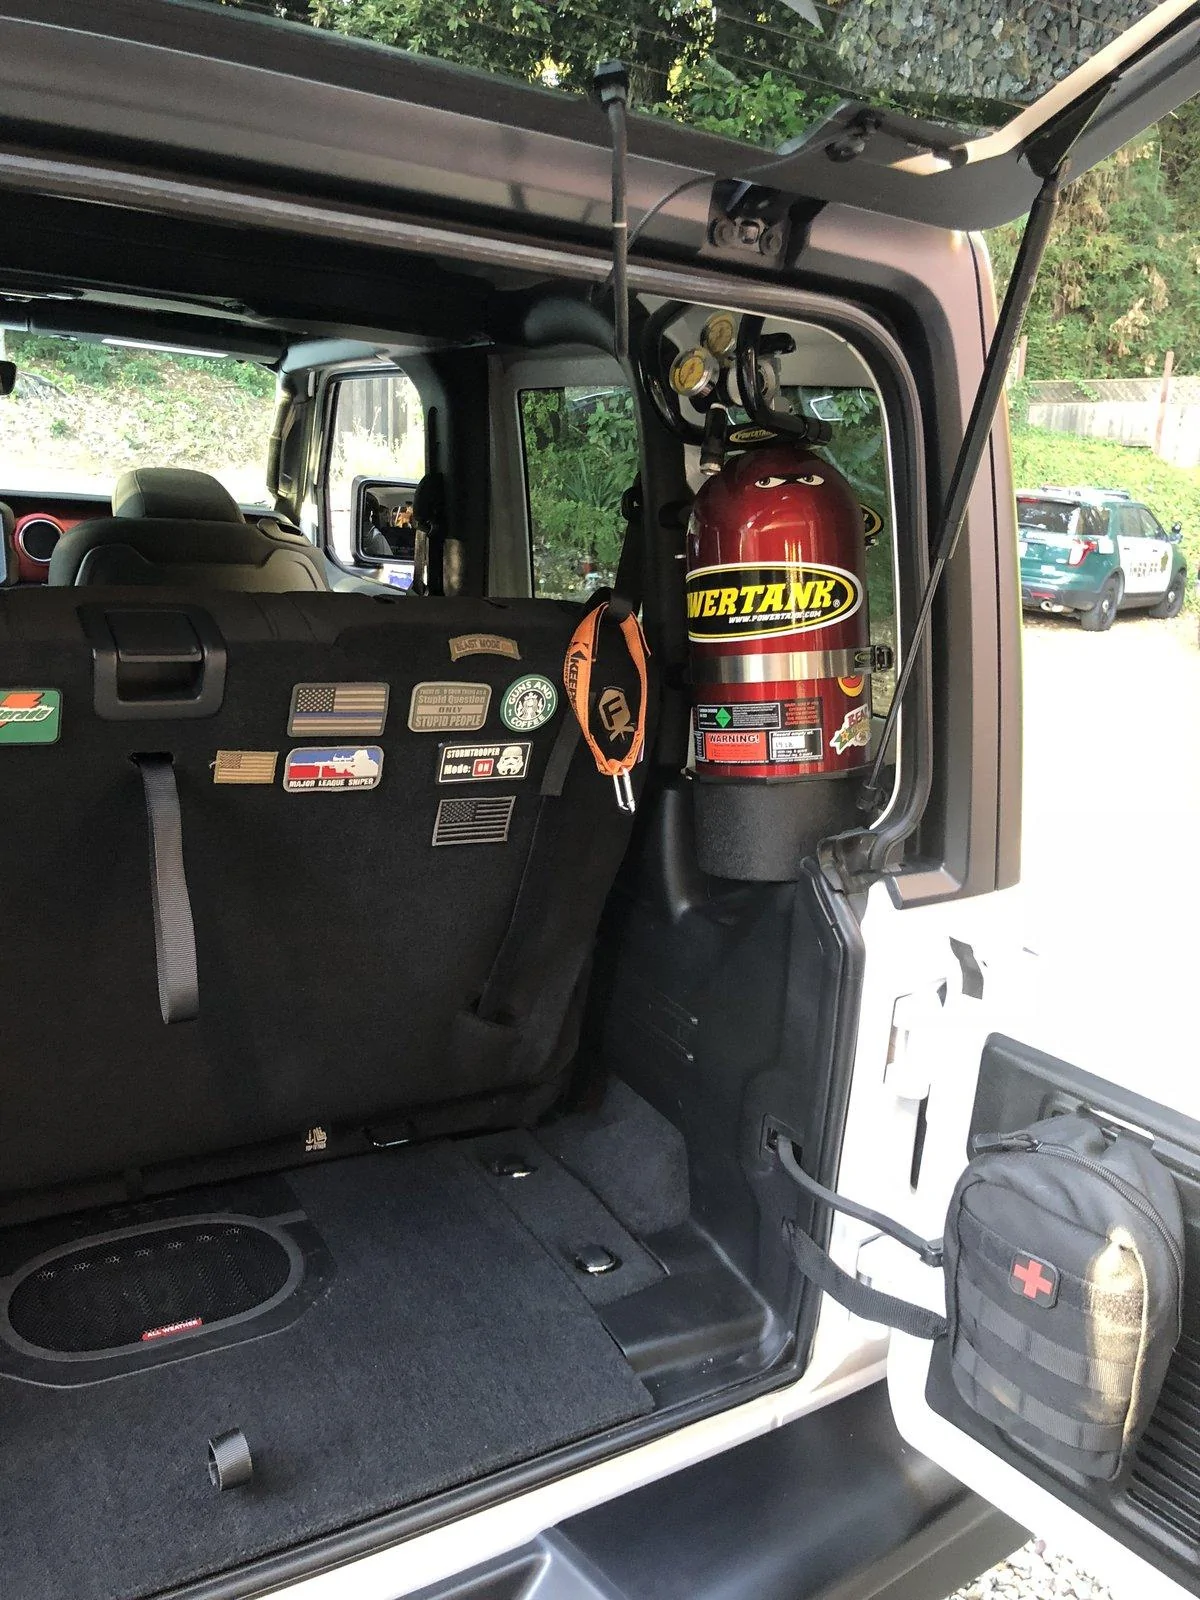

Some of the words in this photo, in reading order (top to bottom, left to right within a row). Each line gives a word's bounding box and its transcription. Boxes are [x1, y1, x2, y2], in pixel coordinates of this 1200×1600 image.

[687, 580, 837, 618] WERTANK
[480, 638, 500, 649] MODE
[508, 681, 532, 704] GUNS
[533, 681, 553, 700] AND
[418, 695, 447, 704] Stupid
[448, 695, 485, 704] Question
[439, 705, 463, 713] ONLY
[415, 716, 448, 727] STUPID
[449, 714, 482, 727] PEOPLE
[510, 714, 546, 728] COFFEE
[709, 734, 760, 744] WARNING!
[446, 747, 500, 758] STORMTROOPER
[443, 763, 471, 775] Mode:
[478, 763, 490, 773] ON
[318, 779, 345, 787] LEAGUE
[348, 777, 374, 786] SNIPER
[147, 1330, 161, 1338] ALL
[162, 1319, 198, 1333] WEATHER
